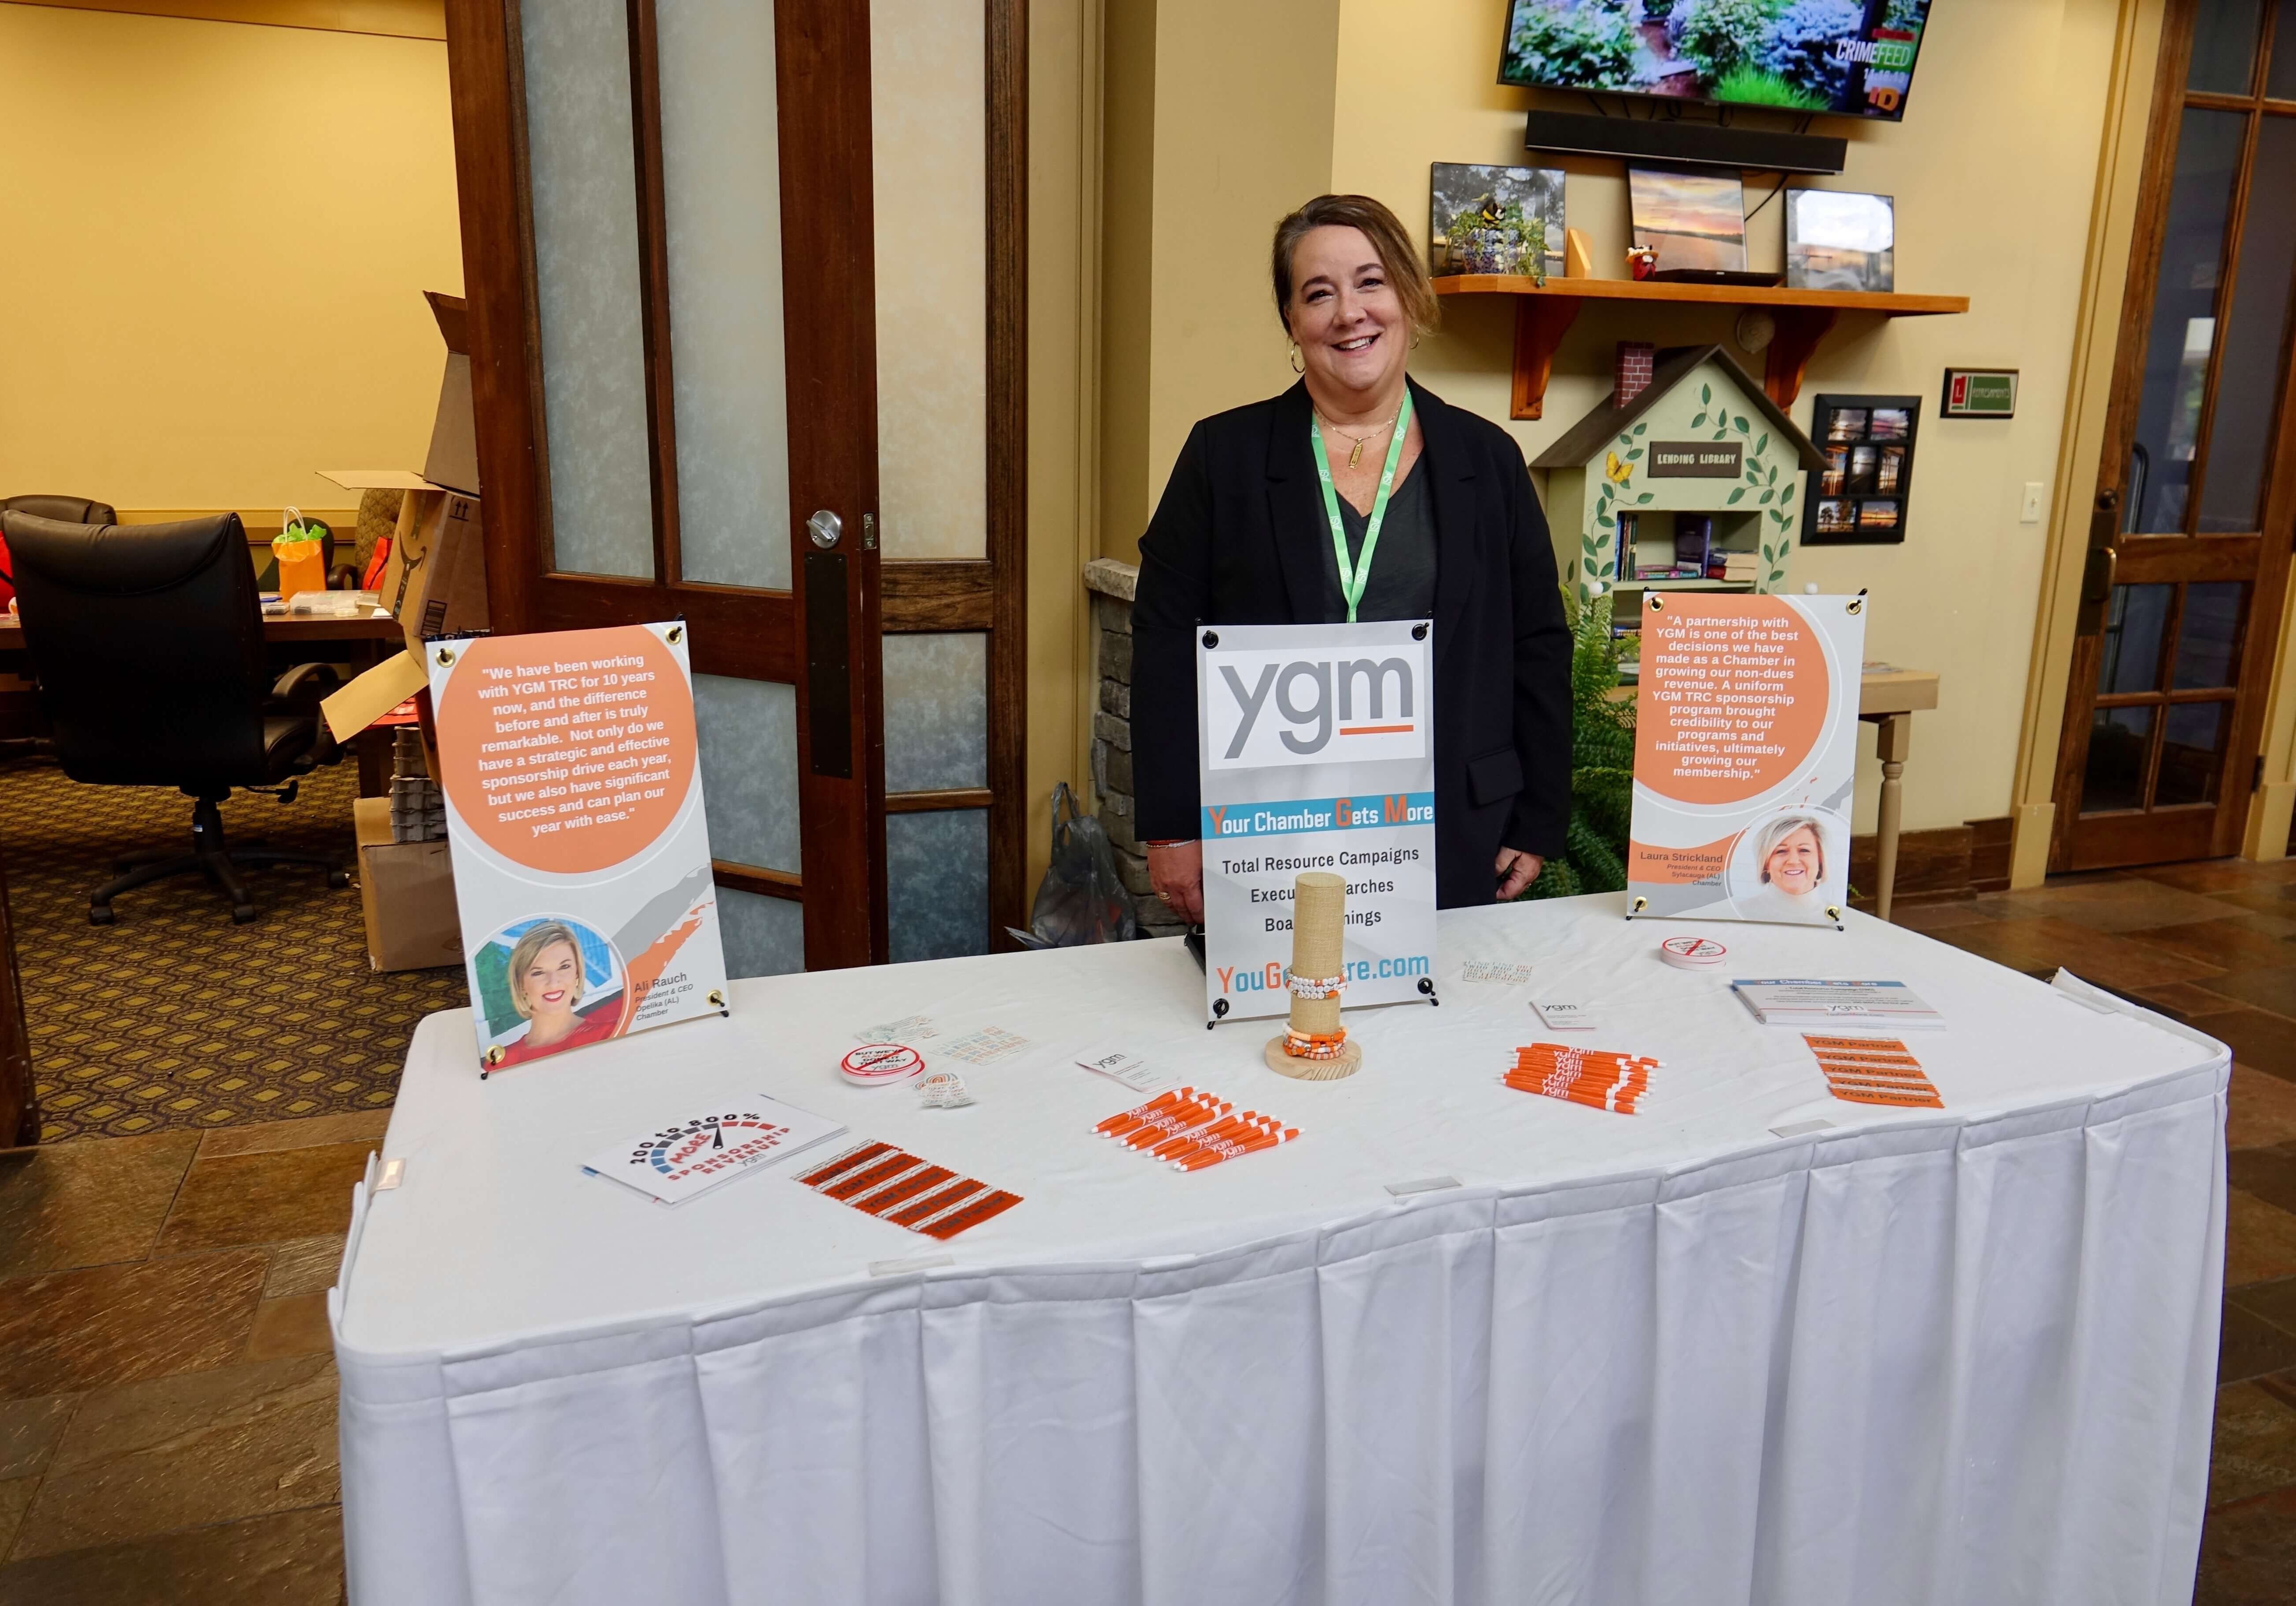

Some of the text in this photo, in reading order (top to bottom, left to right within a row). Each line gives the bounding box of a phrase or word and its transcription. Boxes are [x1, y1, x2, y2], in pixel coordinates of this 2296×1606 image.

[1836, 41, 1911, 66] CRIMEFEED
[1657, 454, 1736, 464] LENDING LIBRARY
[1667, 615, 1788, 629] "A partnership with
[1656, 628, 1685, 638] YGM
[1689, 628, 1700, 638] is
[1731, 629, 1744, 639] of
[1747, 630, 1767, 640] the
[1771, 630, 1798, 641] best
[1669, 641, 1729, 652] decisions
[1754, 642, 1784, 653] have
[482, 655, 644, 679] "We have been working
[1656, 653, 1690, 663] made
[1723, 655, 1780, 665] Chamber
[1784, 656, 1795, 666] in
[1656, 666, 1706, 678] growing
[1735, 668, 1794, 678] non-dues
[478, 672, 655, 699] with YGM TRC for 10 years
[1664, 680, 1784, 691] revenue. A uniform
[493, 690, 647, 715] now, and the difference
[1652, 691, 1794, 706] YGM TRC sponsorship
[1218, 657, 1413, 759] ygm
[1669, 705, 1776, 718] program brought
[495, 704, 648, 733] before and after is truly
[1670, 717, 1732, 729] credibility
[1736, 718, 1748, 728] to
[482, 721, 663, 753] remarkable. Not only do we
[1678, 731, 1764, 741] programs and
[478, 736, 670, 771] have a strategic and effective
[1656, 740, 1785, 756] initiatives, ultimately
[1682, 755, 1757, 767] growing our
[482, 754, 671, 791] sponsorship drive each year,
[1673, 767, 1760, 780] membership."
[488, 769, 670, 805] but we also have significant
[498, 788, 665, 822] success and can plan our
[532, 807, 635, 838] year with ease."
[1208, 796, 1433, 835] Your Chamber Gets More
[1222, 848, 1419, 874] Total Resource Campaigns
[1640, 851, 1722, 863] Laura Strickland
[1251, 880, 1394, 902] Execu arches
[1265, 918, 1293, 931] Boa
[634, 972, 687, 993] Ali Rauch
[635, 990, 669, 1003] President
[677, 983, 693, 992] CEO
[636, 996, 679, 1012] Opelika (AL)
[636, 1009, 668, 1020] Chamber
[1092, 1053, 1126, 1068] ygm
[1553, 1050, 1579, 1059] ygm
[1556, 1062, 1582, 1072] ygm
[1542, 1085, 1569, 1097] ygm
[1126, 1105, 1148, 1120] ygm
[1138, 1109, 1163, 1126] ygm
[1164, 1121, 1187, 1137] ygm
[667, 1127, 790, 1180] SPONSORSHIP
[669, 1133, 712, 1164] MORE
[1219, 1145, 1245, 1161] ygm
[701, 1140, 781, 1174] REVENUE
[737, 1153, 767, 1167] ygm
